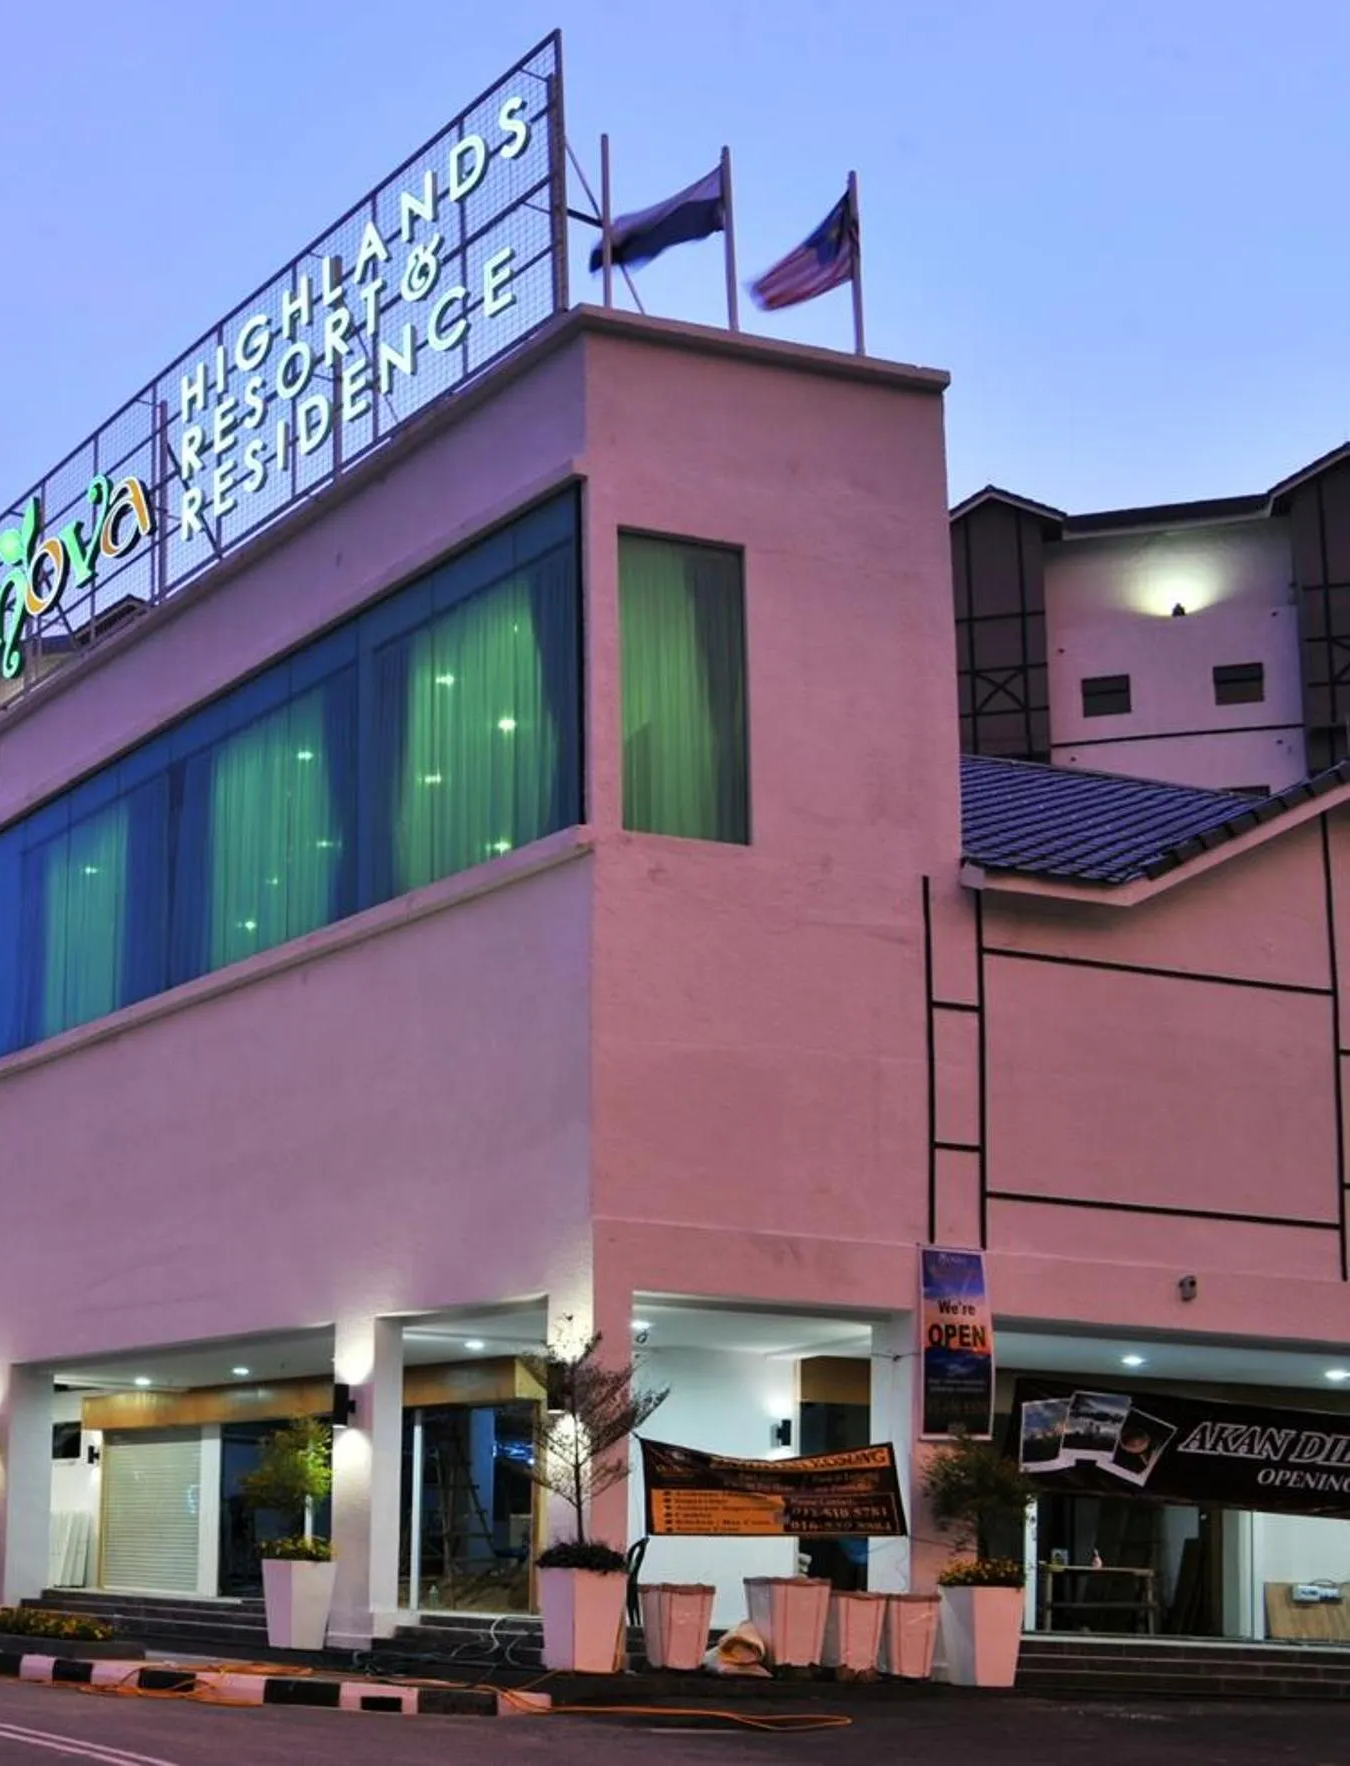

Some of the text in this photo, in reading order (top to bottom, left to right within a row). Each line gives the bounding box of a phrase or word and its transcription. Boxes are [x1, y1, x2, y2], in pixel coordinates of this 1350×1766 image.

[180, 96, 529, 423] HIGHLANDS
[180, 232, 443, 480] RESORT &
[180, 247, 516, 542] RESIDENCE
[927, 1323, 987, 1348] OPEN
[938, 1300, 977, 1317] We're
[1177, 1421, 1297, 1461] AKAN
